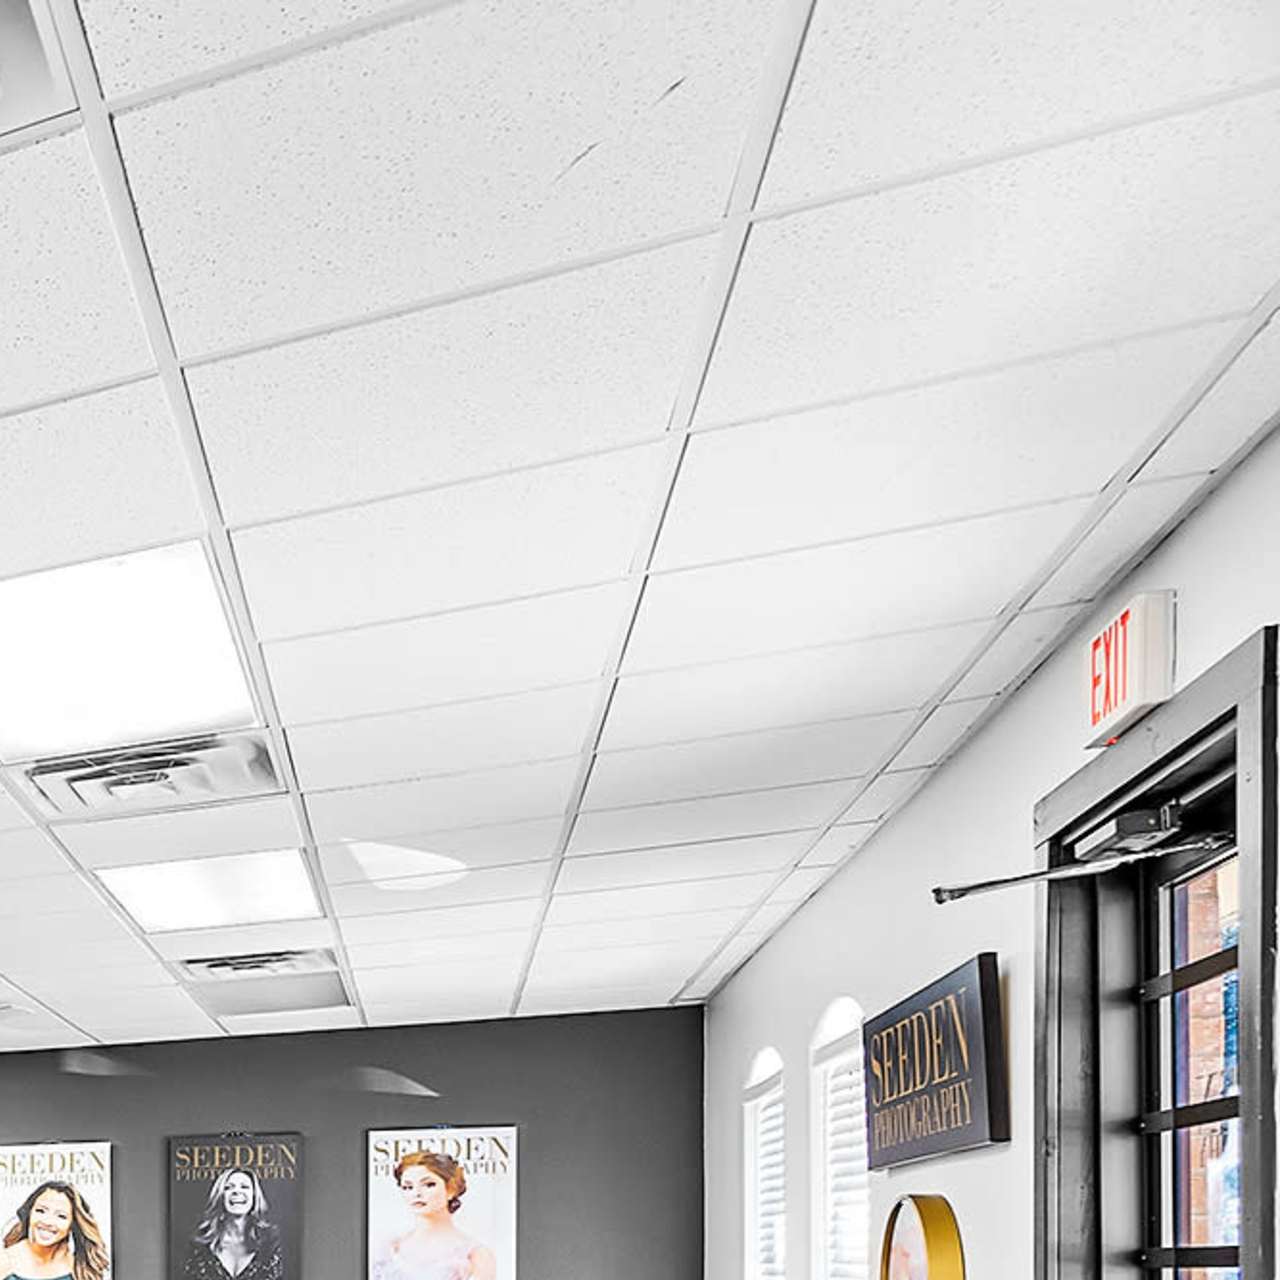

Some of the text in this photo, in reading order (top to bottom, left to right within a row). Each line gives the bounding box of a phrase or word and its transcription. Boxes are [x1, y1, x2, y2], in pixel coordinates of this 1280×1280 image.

[1091, 608, 1130, 726] EXIT
[870, 987, 970, 1108] SEEDEN
[176, 1143, 297, 1168] SEEDEN
[874, 1078, 973, 1150] PHOTOGRAPHY
